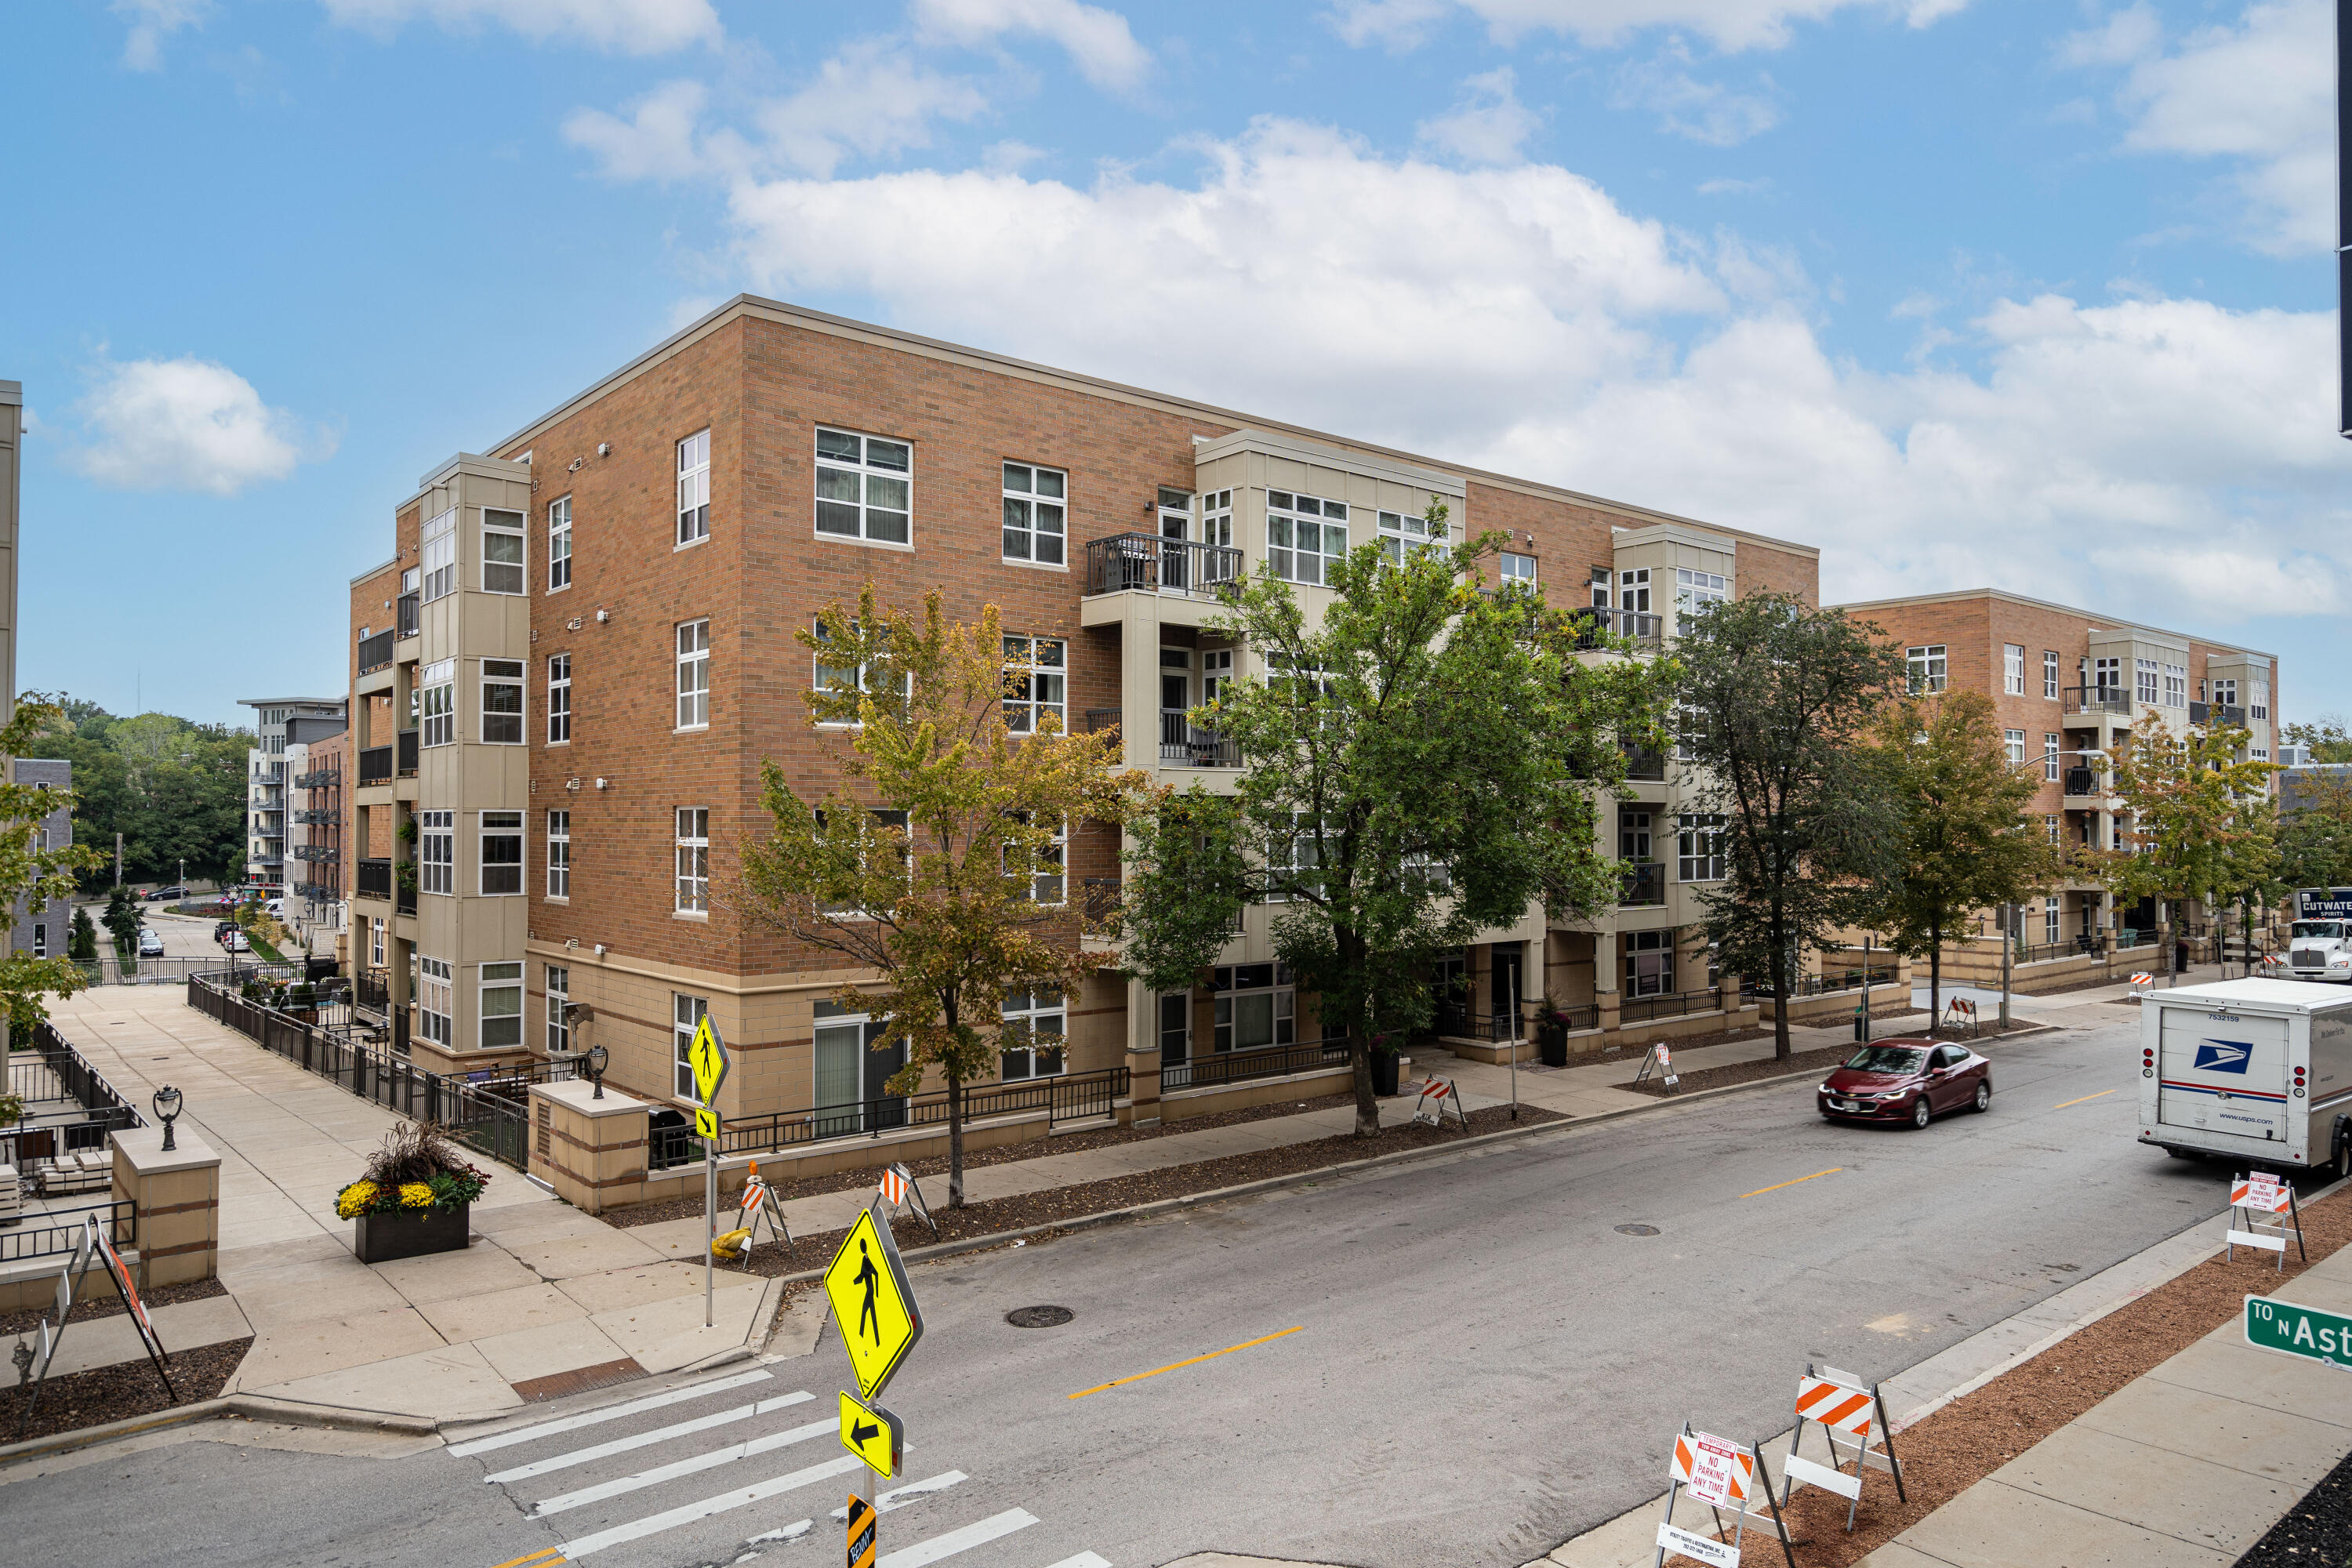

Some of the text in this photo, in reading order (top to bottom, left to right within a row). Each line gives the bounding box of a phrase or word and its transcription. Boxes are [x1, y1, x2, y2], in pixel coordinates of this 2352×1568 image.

[2303, 902, 2352, 911] CUTWATE
[2209, 1014, 2240, 1022] 7532159
[2220, 1112, 2273, 1125] www.usps.com
[2252, 1189, 2272, 1198] PARKING
[2252, 1302, 2273, 1321] TO
[2278, 1316, 2352, 1357] N Ast
[1703, 1436, 1733, 1450] TEMPORARY
[1708, 1456, 1719, 1468] NO
[1697, 1465, 1725, 1482] PARKING
[1693, 1475, 1724, 1494] ANY TIME
[850, 1526, 873, 1564] BENNY
